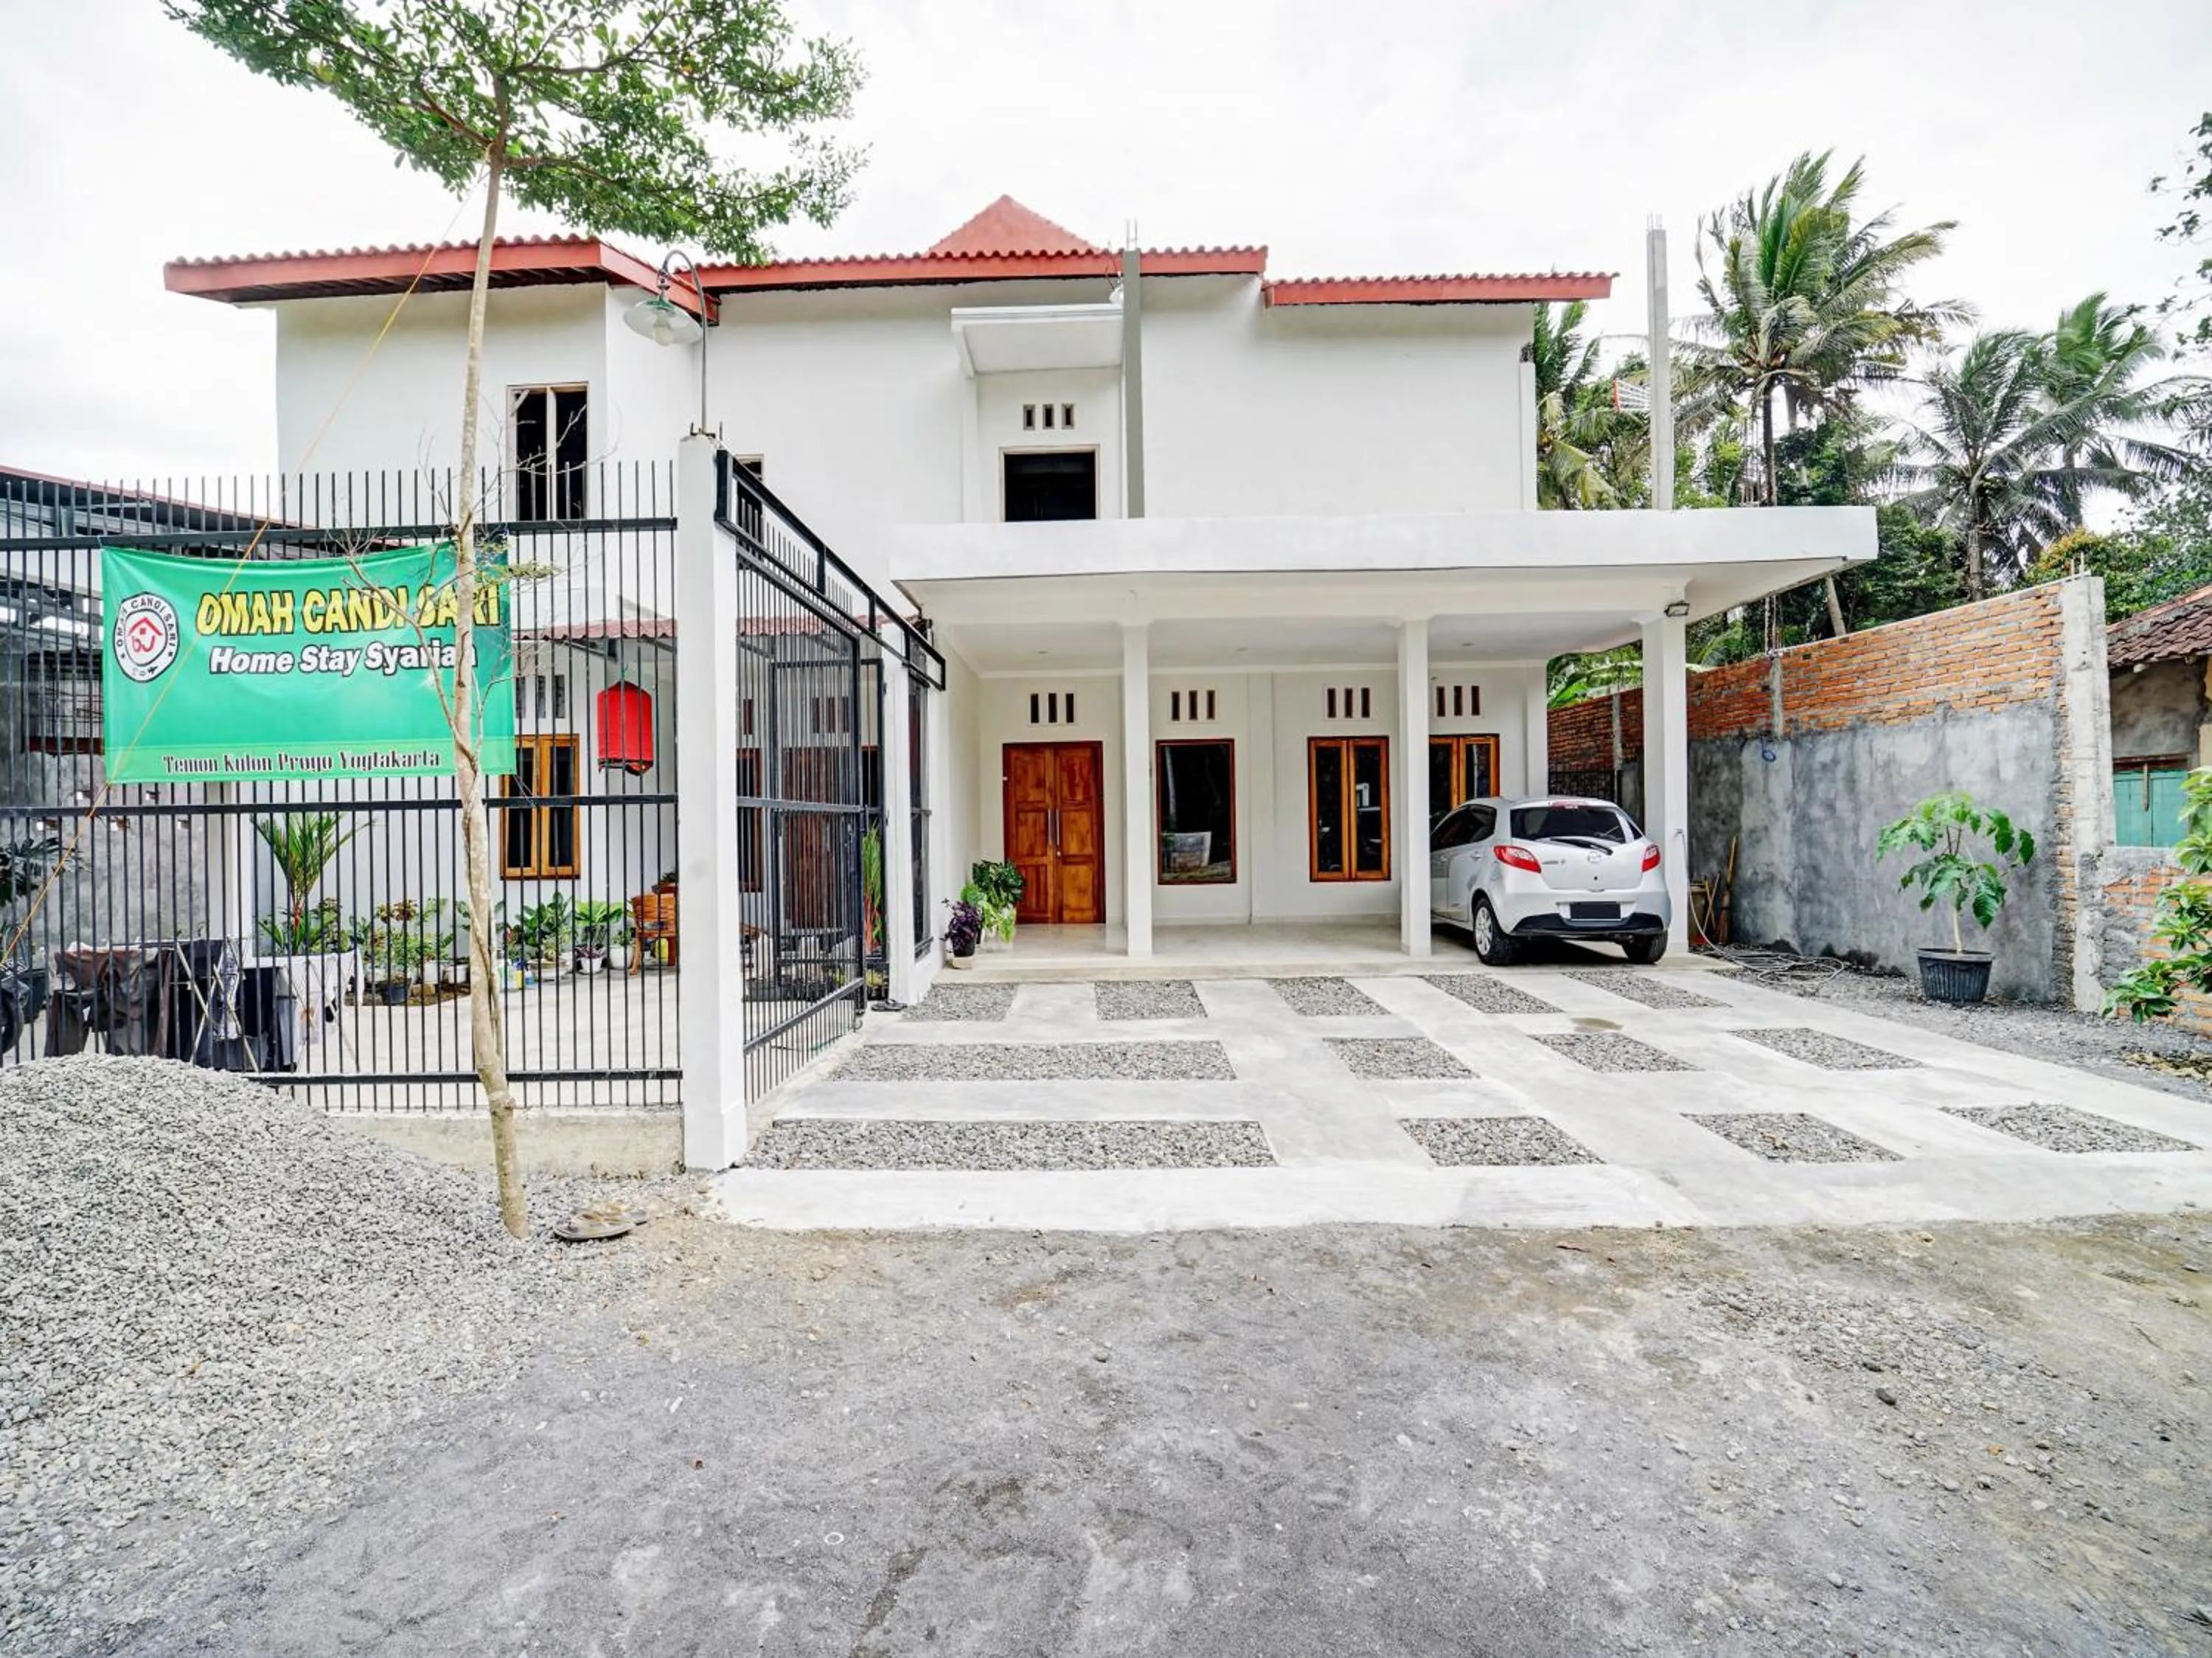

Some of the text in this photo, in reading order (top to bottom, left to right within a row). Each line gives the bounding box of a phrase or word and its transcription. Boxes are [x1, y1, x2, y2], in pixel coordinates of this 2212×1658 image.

[131, 597, 167, 613] CANDI
[164, 613, 176, 647] SARI
[197, 589, 295, 636] OMAH
[302, 585, 409, 634] CANDI
[209, 637, 479, 678] Home Stay Syaria
[163, 755, 219, 774] Temon
[223, 754, 273, 772] Kulon
[278, 752, 333, 773] Progo
